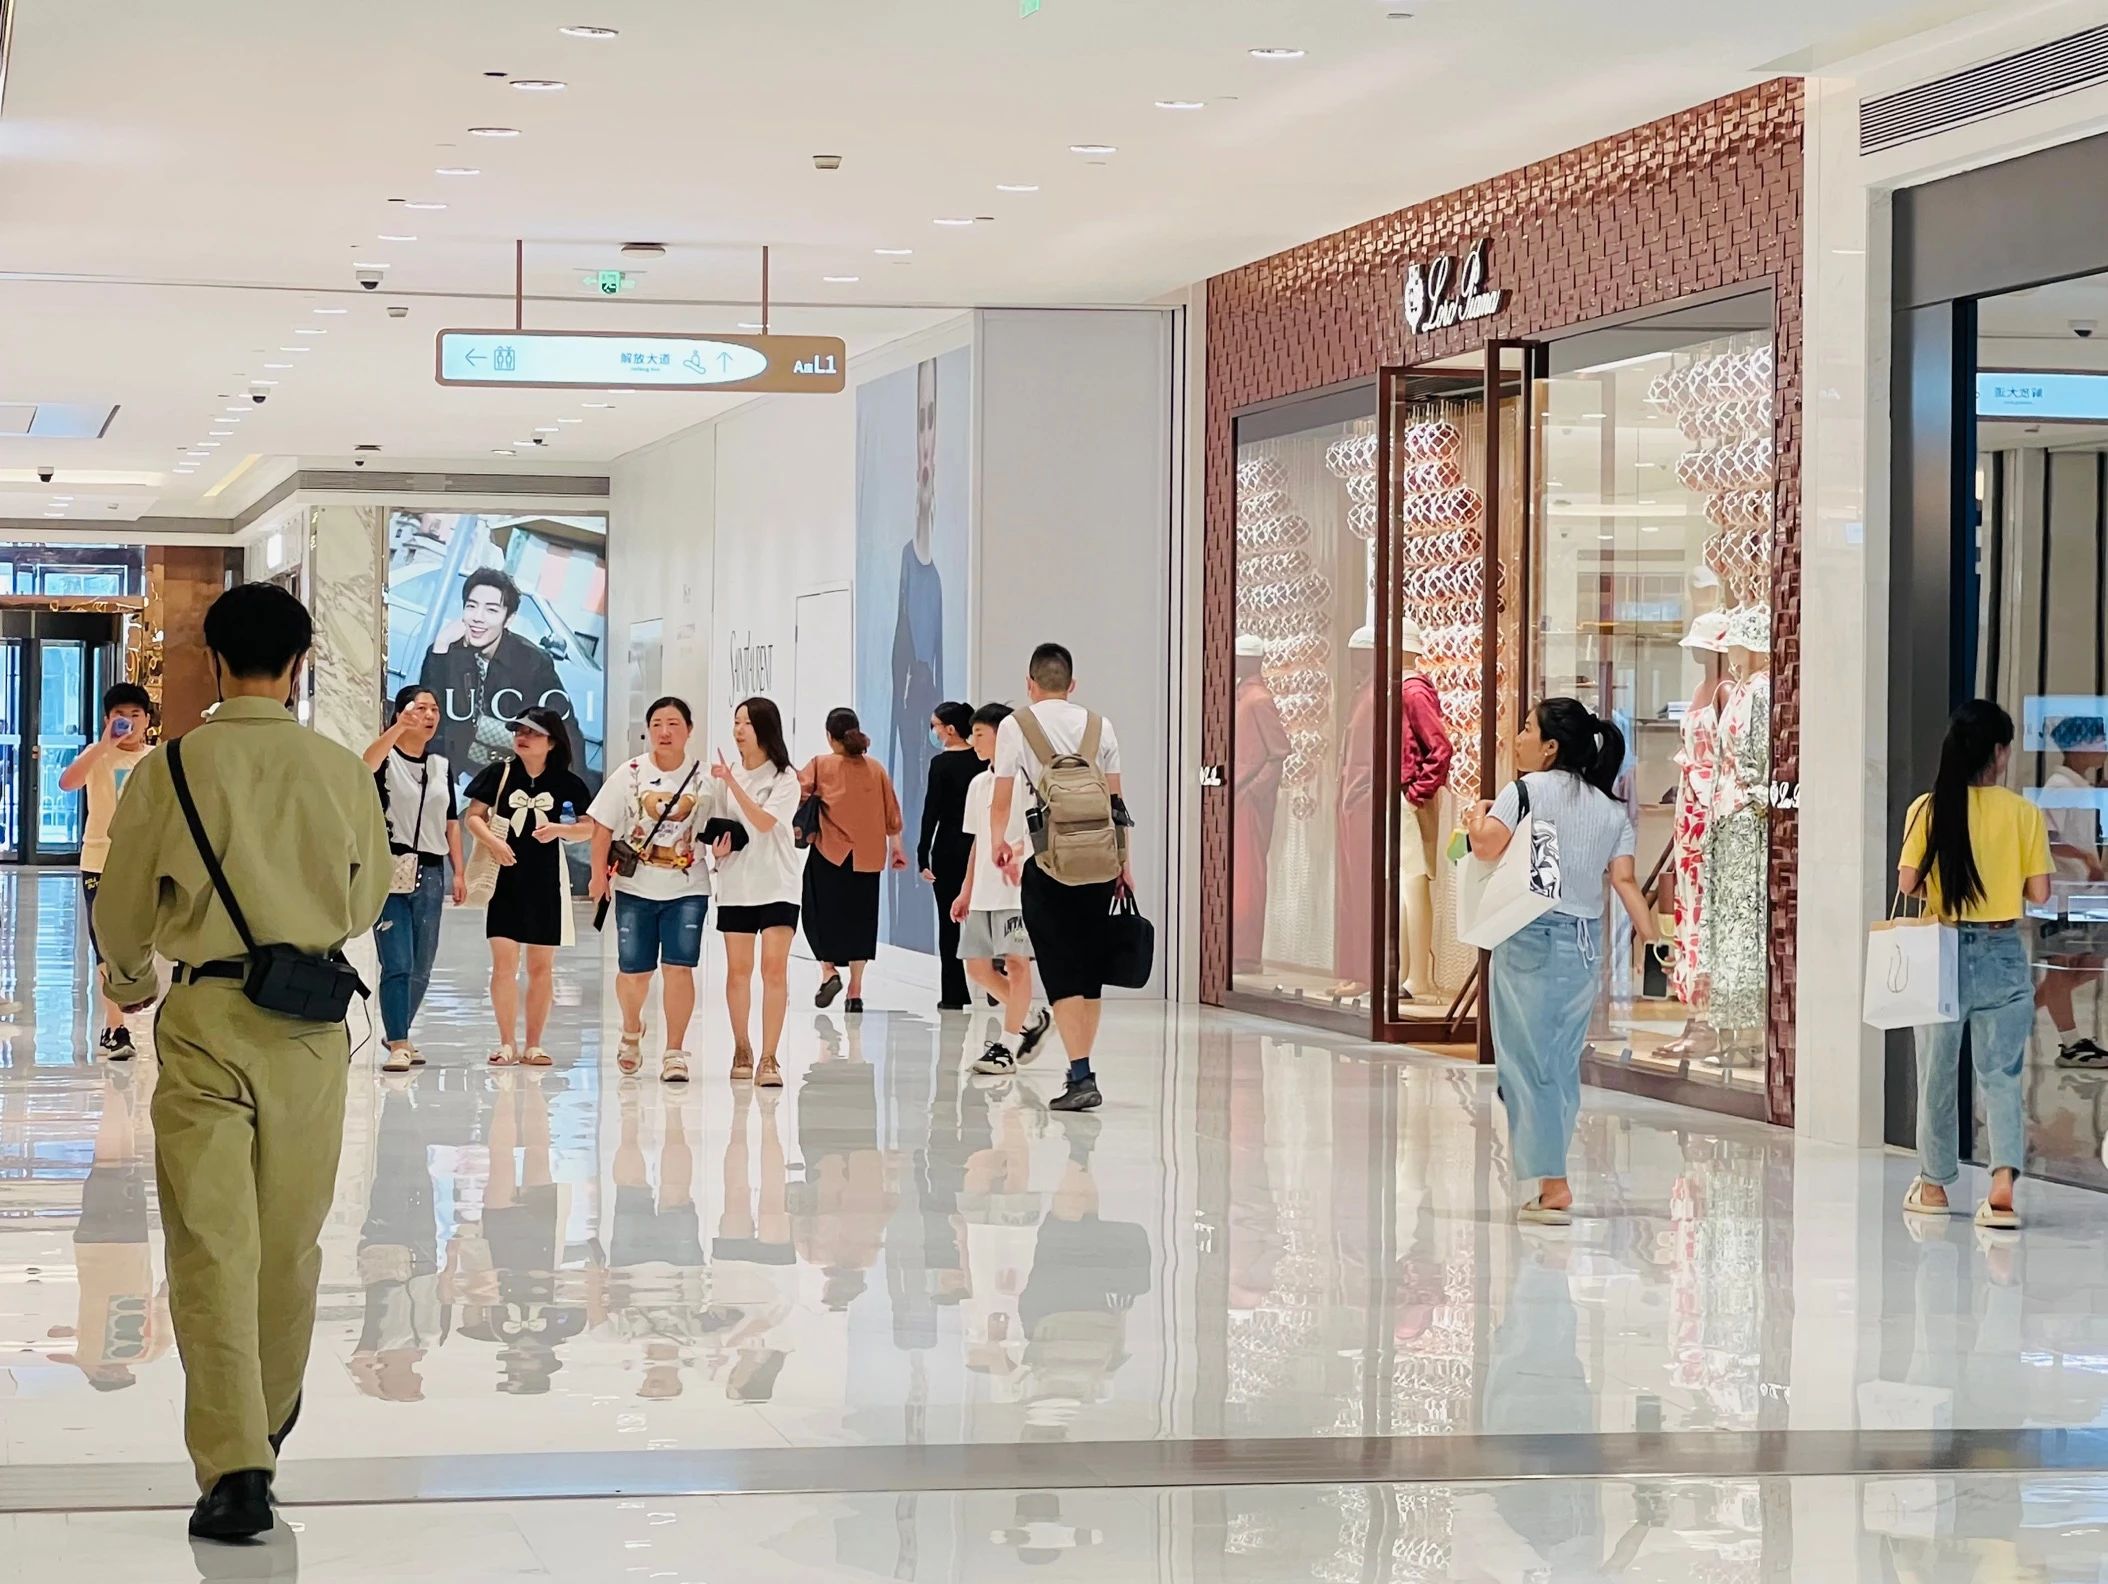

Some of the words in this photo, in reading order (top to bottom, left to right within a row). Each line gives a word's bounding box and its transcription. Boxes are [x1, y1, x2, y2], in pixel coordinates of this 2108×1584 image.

[620, 351, 671, 366] 解放大道
[445, 688, 595, 722] UCCI
